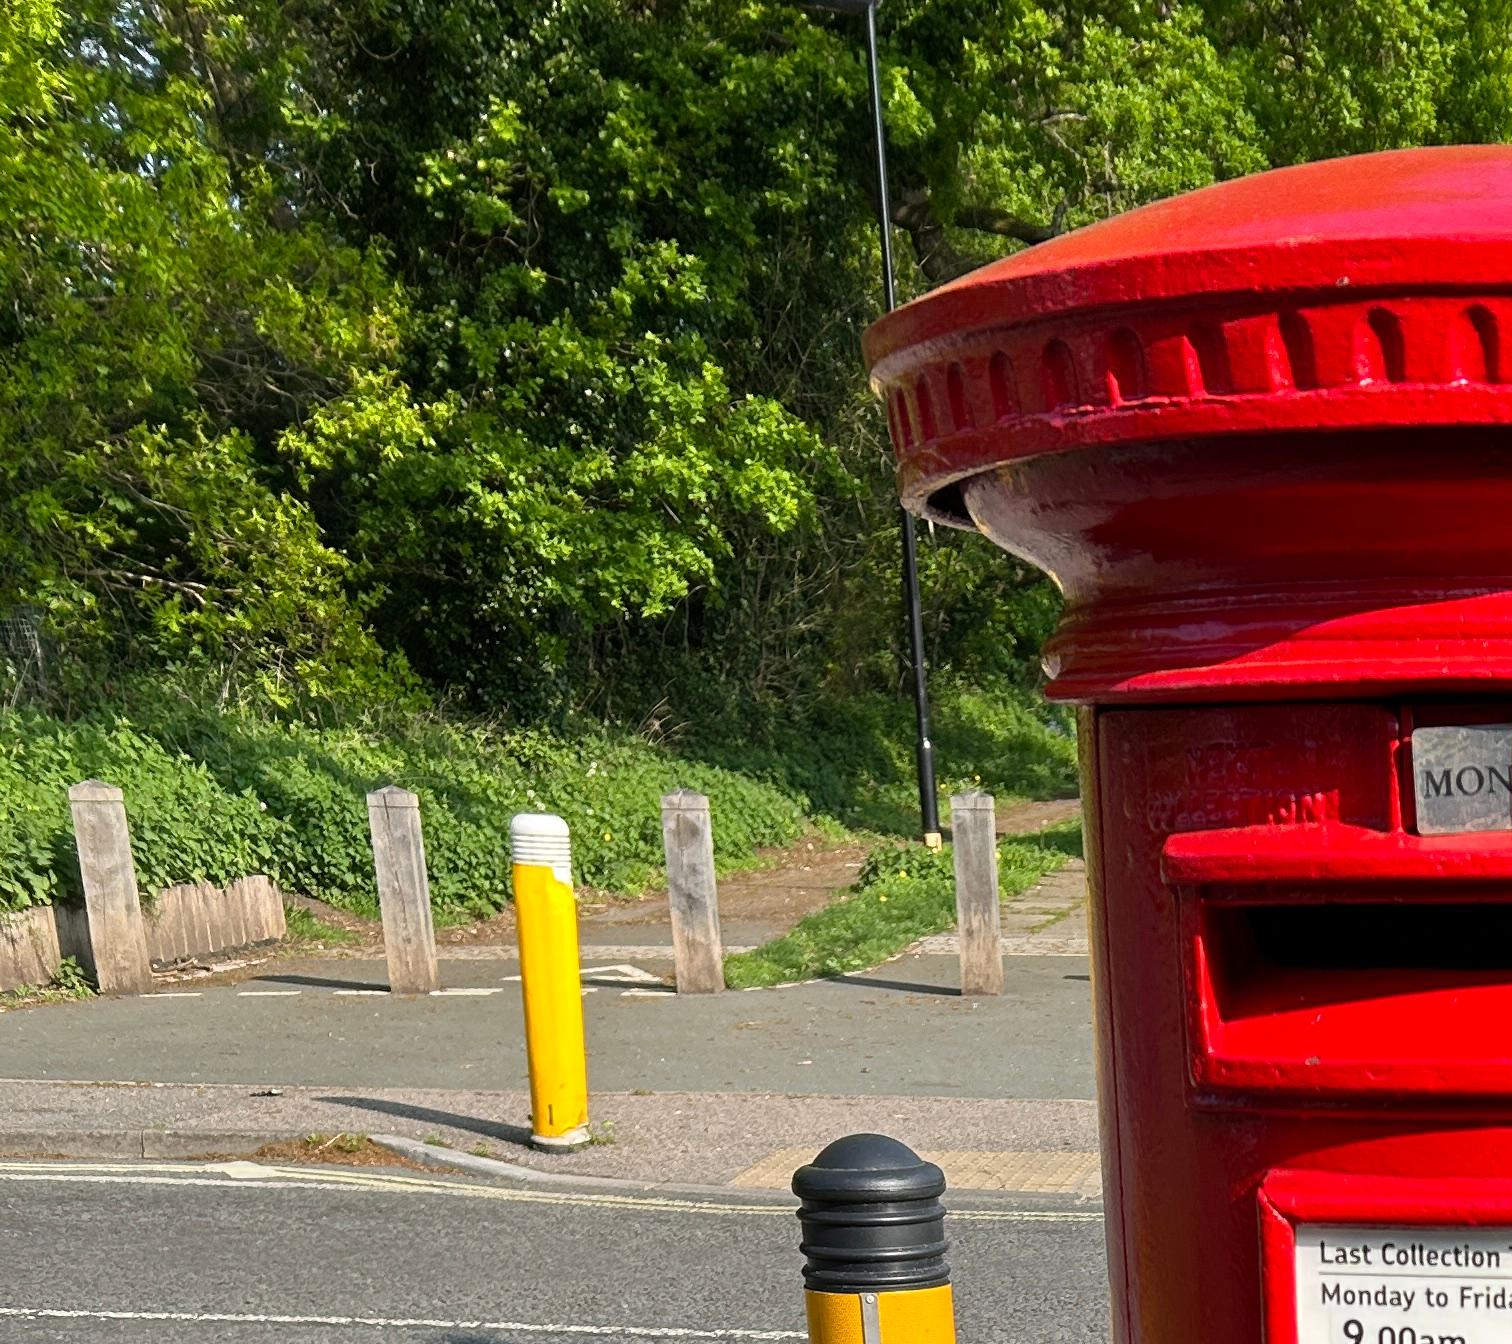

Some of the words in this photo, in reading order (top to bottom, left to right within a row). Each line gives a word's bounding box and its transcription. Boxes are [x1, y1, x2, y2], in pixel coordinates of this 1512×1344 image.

[1423, 765, 1512, 799] MON
[1319, 1241, 1372, 1265] Last
[1382, 1244, 1500, 1268] Collection
[1321, 1283, 1415, 1312] Monday
[1425, 1287, 1448, 1308] to
